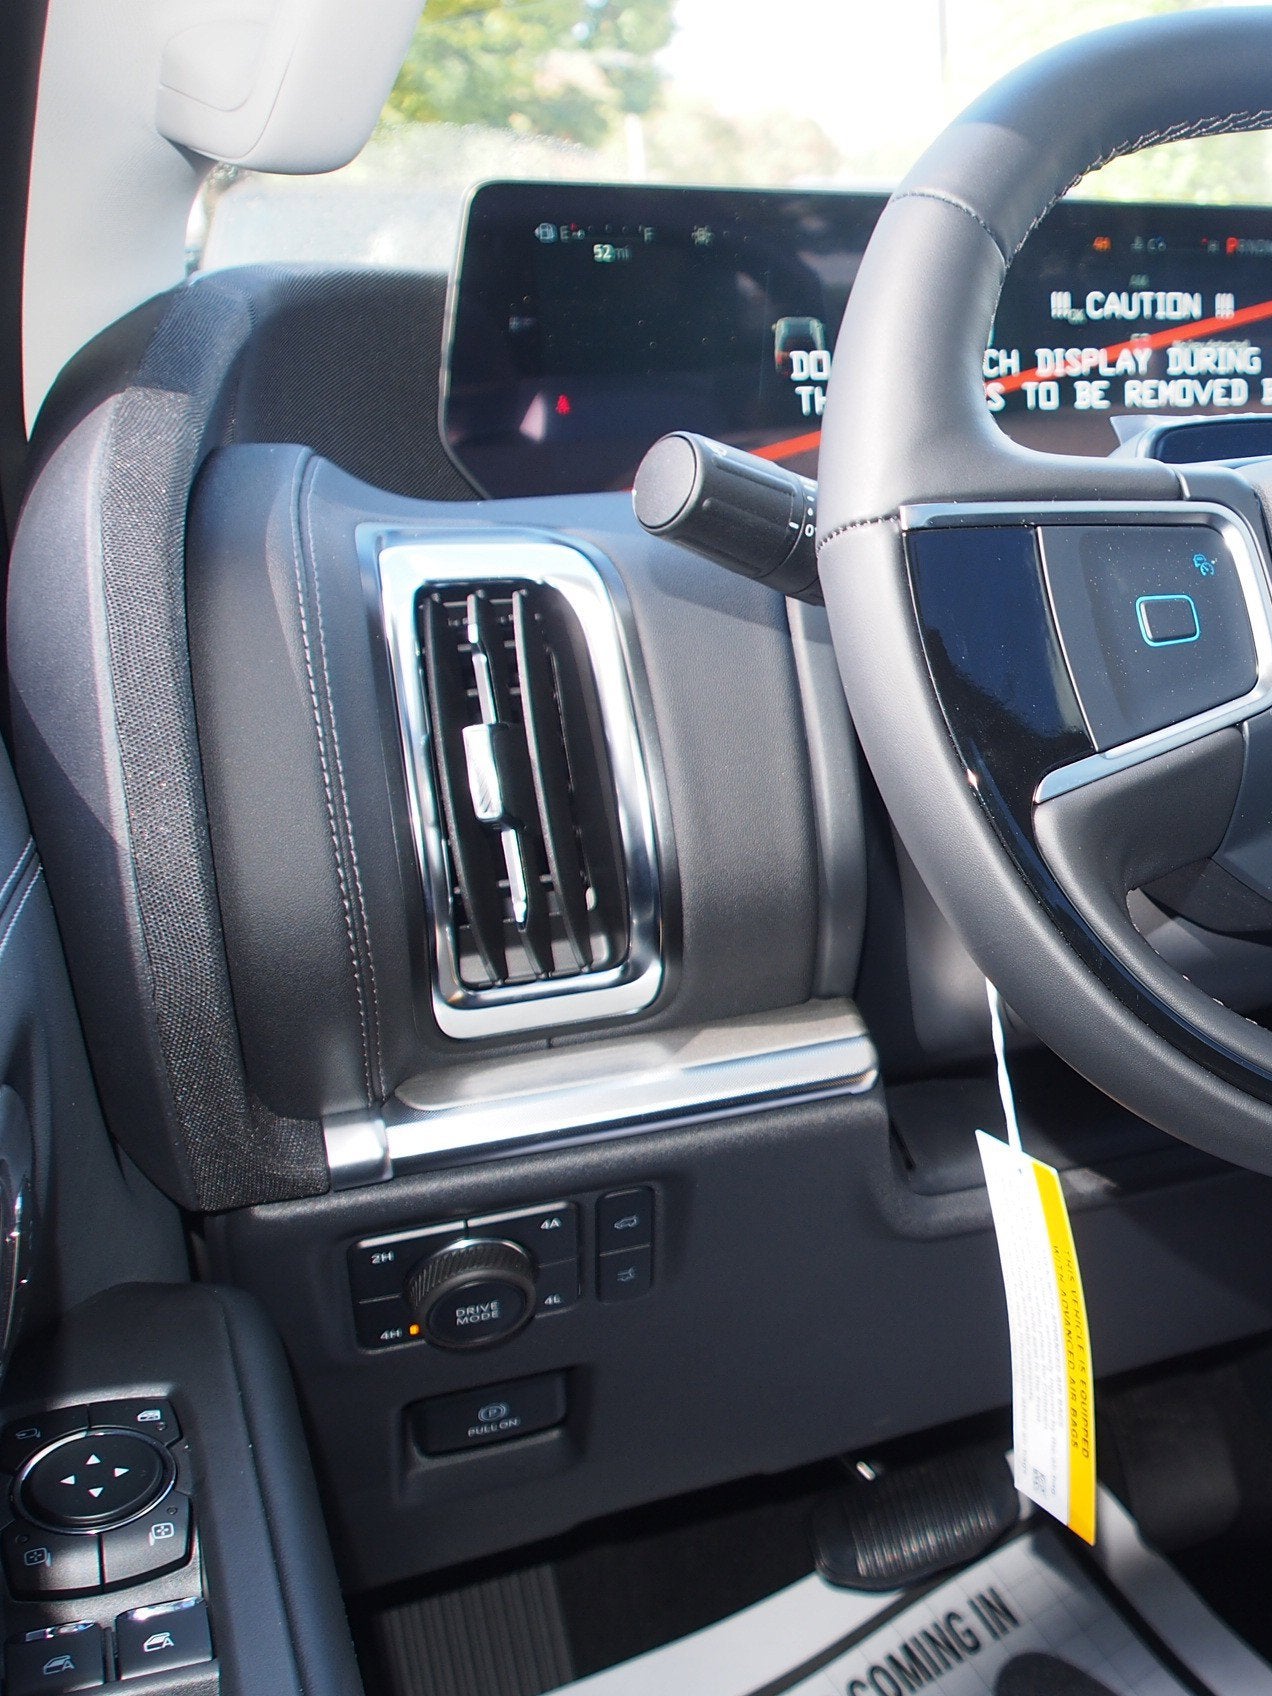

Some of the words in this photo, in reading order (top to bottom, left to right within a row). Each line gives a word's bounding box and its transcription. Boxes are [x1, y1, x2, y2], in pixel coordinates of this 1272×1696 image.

[593, 243, 615, 263] 52
[1086, 290, 1203, 320] CAUTION
[790, 350, 831, 381] DO
[1035, 347, 1152, 378] DISPLAY
[1167, 346, 1262, 376] DURING
[1021, 381, 1059, 411] TO
[1073, 380, 1111, 410] BE
[1124, 378, 1249, 409] REMOVED
[540, 1217, 562, 1231] 4A
[371, 1251, 395, 1266] 2H
[455, 1301, 499, 1318] DRIVE
[456, 1310, 500, 1326] MODE
[380, 1328, 402, 1341] 4H
[1061, 1289, 1075, 1371] ADVANCED
[1070, 1407, 1079, 1448] BAGS
[467, 1423, 498, 1438] PULL
[499, 1418, 518, 1430] ON
[1080, 1380, 1090, 1459] EQUIPPED
[966, 1587, 1020, 1642] IN
